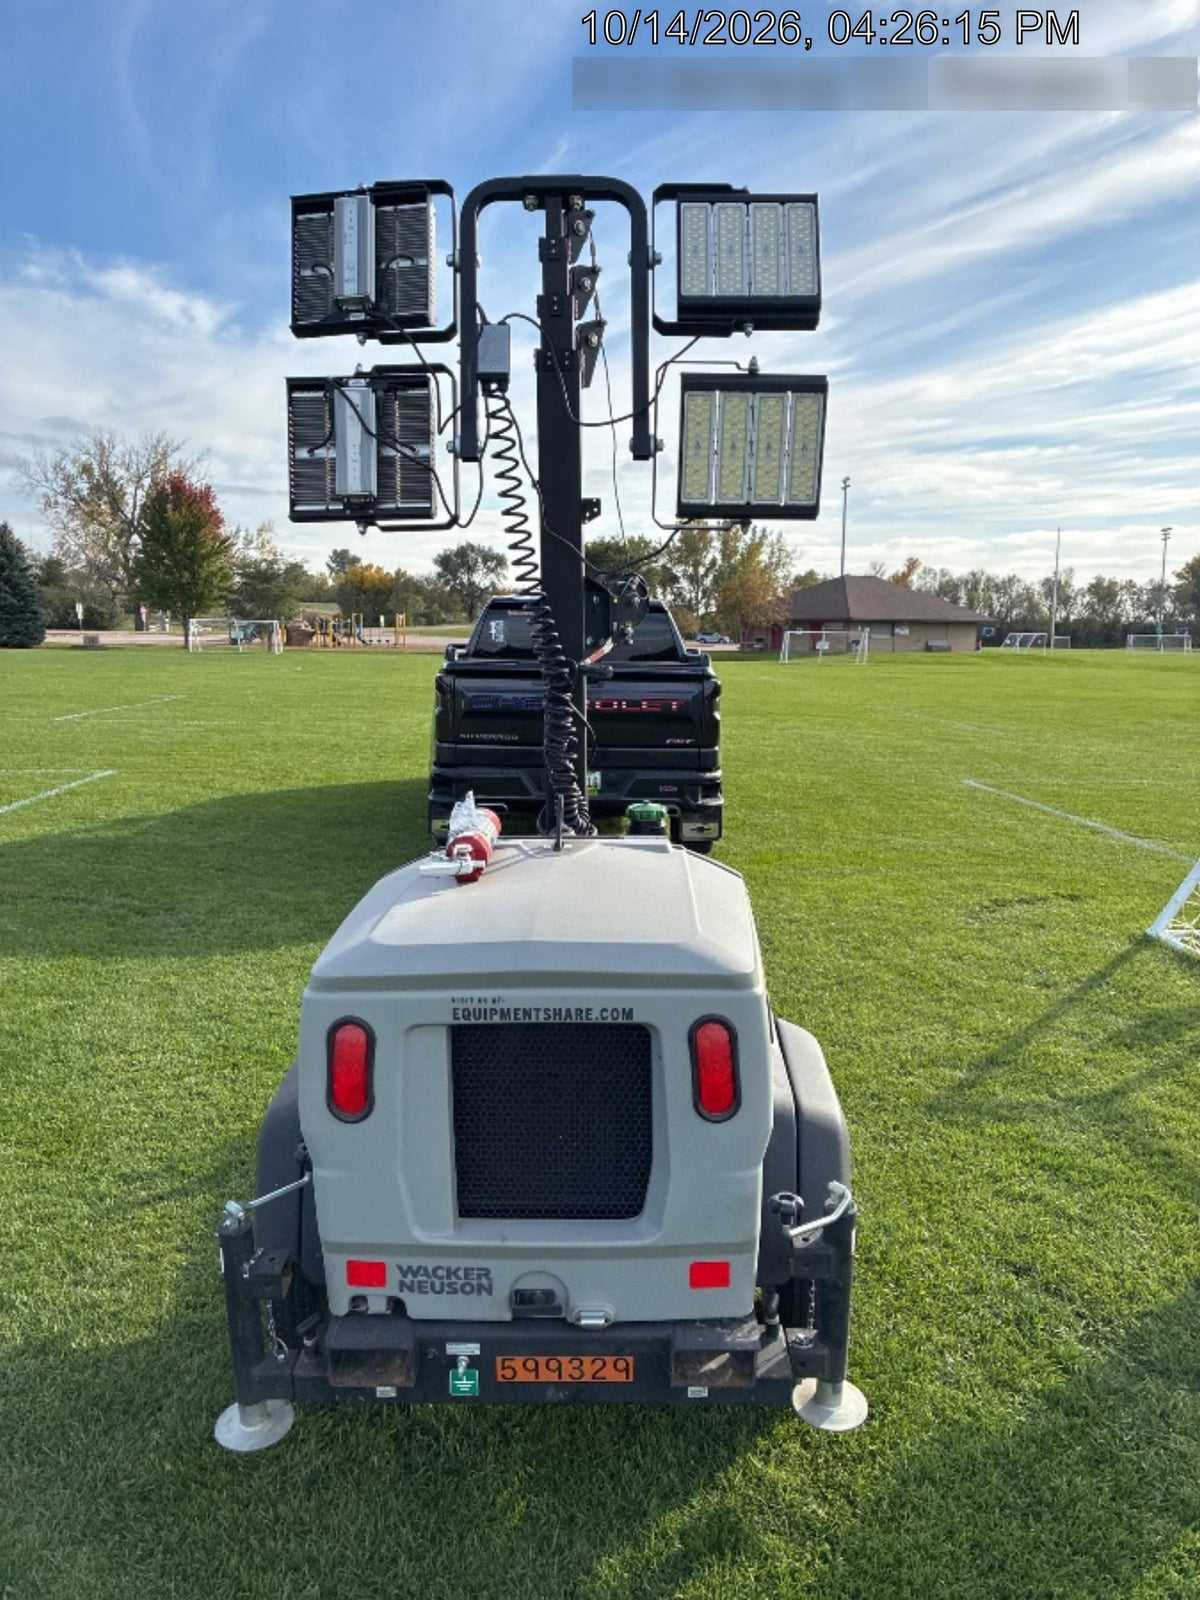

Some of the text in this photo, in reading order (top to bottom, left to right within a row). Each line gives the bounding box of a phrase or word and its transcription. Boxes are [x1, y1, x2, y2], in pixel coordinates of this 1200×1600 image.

[470, 696, 682, 712] CHEOLET
[452, 1007, 633, 1021] EQUIPMENTSHARE.COM
[396, 1264, 492, 1281] WACKER
[398, 1280, 493, 1297] NEUSON
[499, 1356, 631, 1381] 599329
